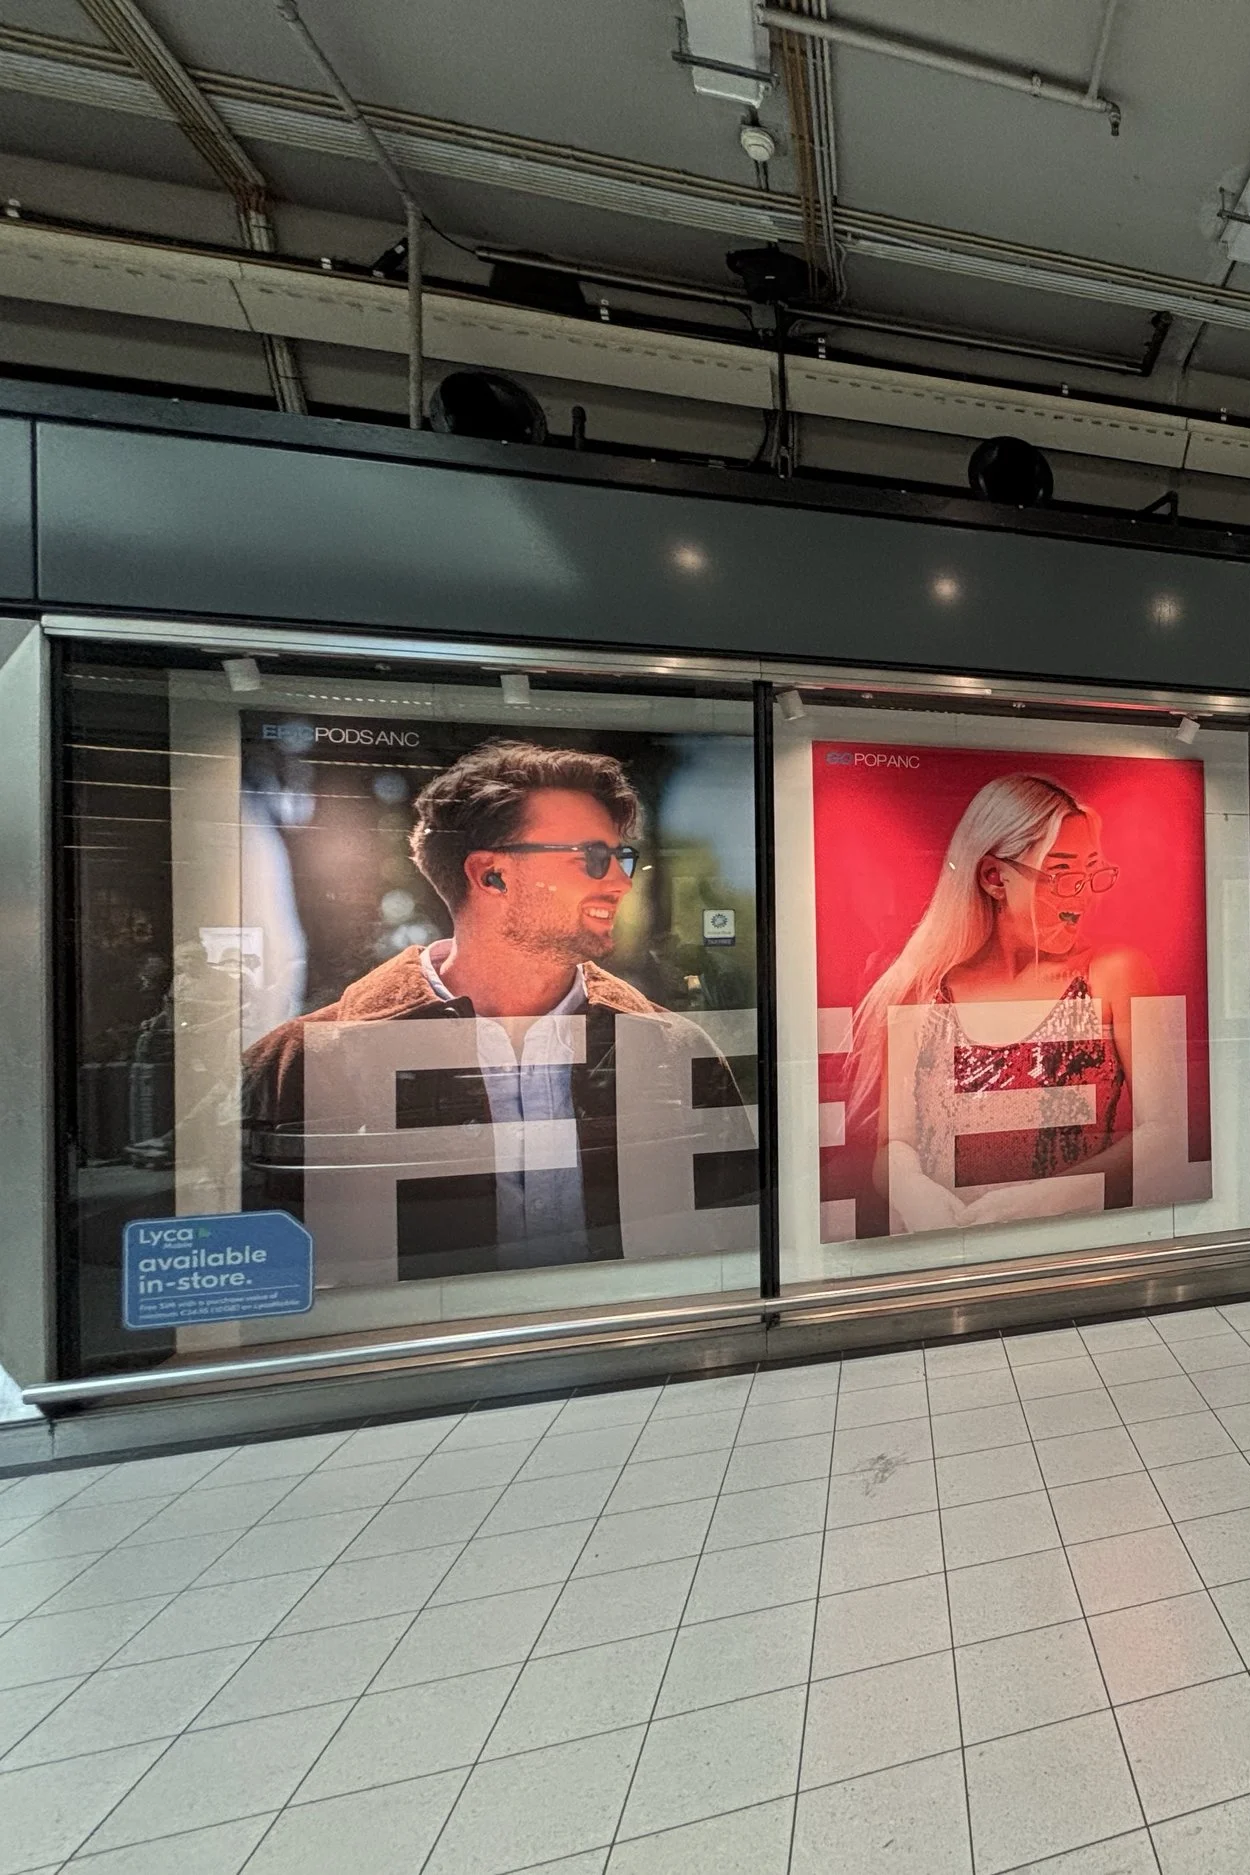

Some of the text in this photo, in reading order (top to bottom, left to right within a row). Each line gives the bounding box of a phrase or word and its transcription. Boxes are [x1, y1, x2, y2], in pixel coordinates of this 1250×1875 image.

[138, 1228, 193, 1246] Lyca
[138, 1246, 267, 1272] available
[138, 1272, 252, 1294] in-store.
